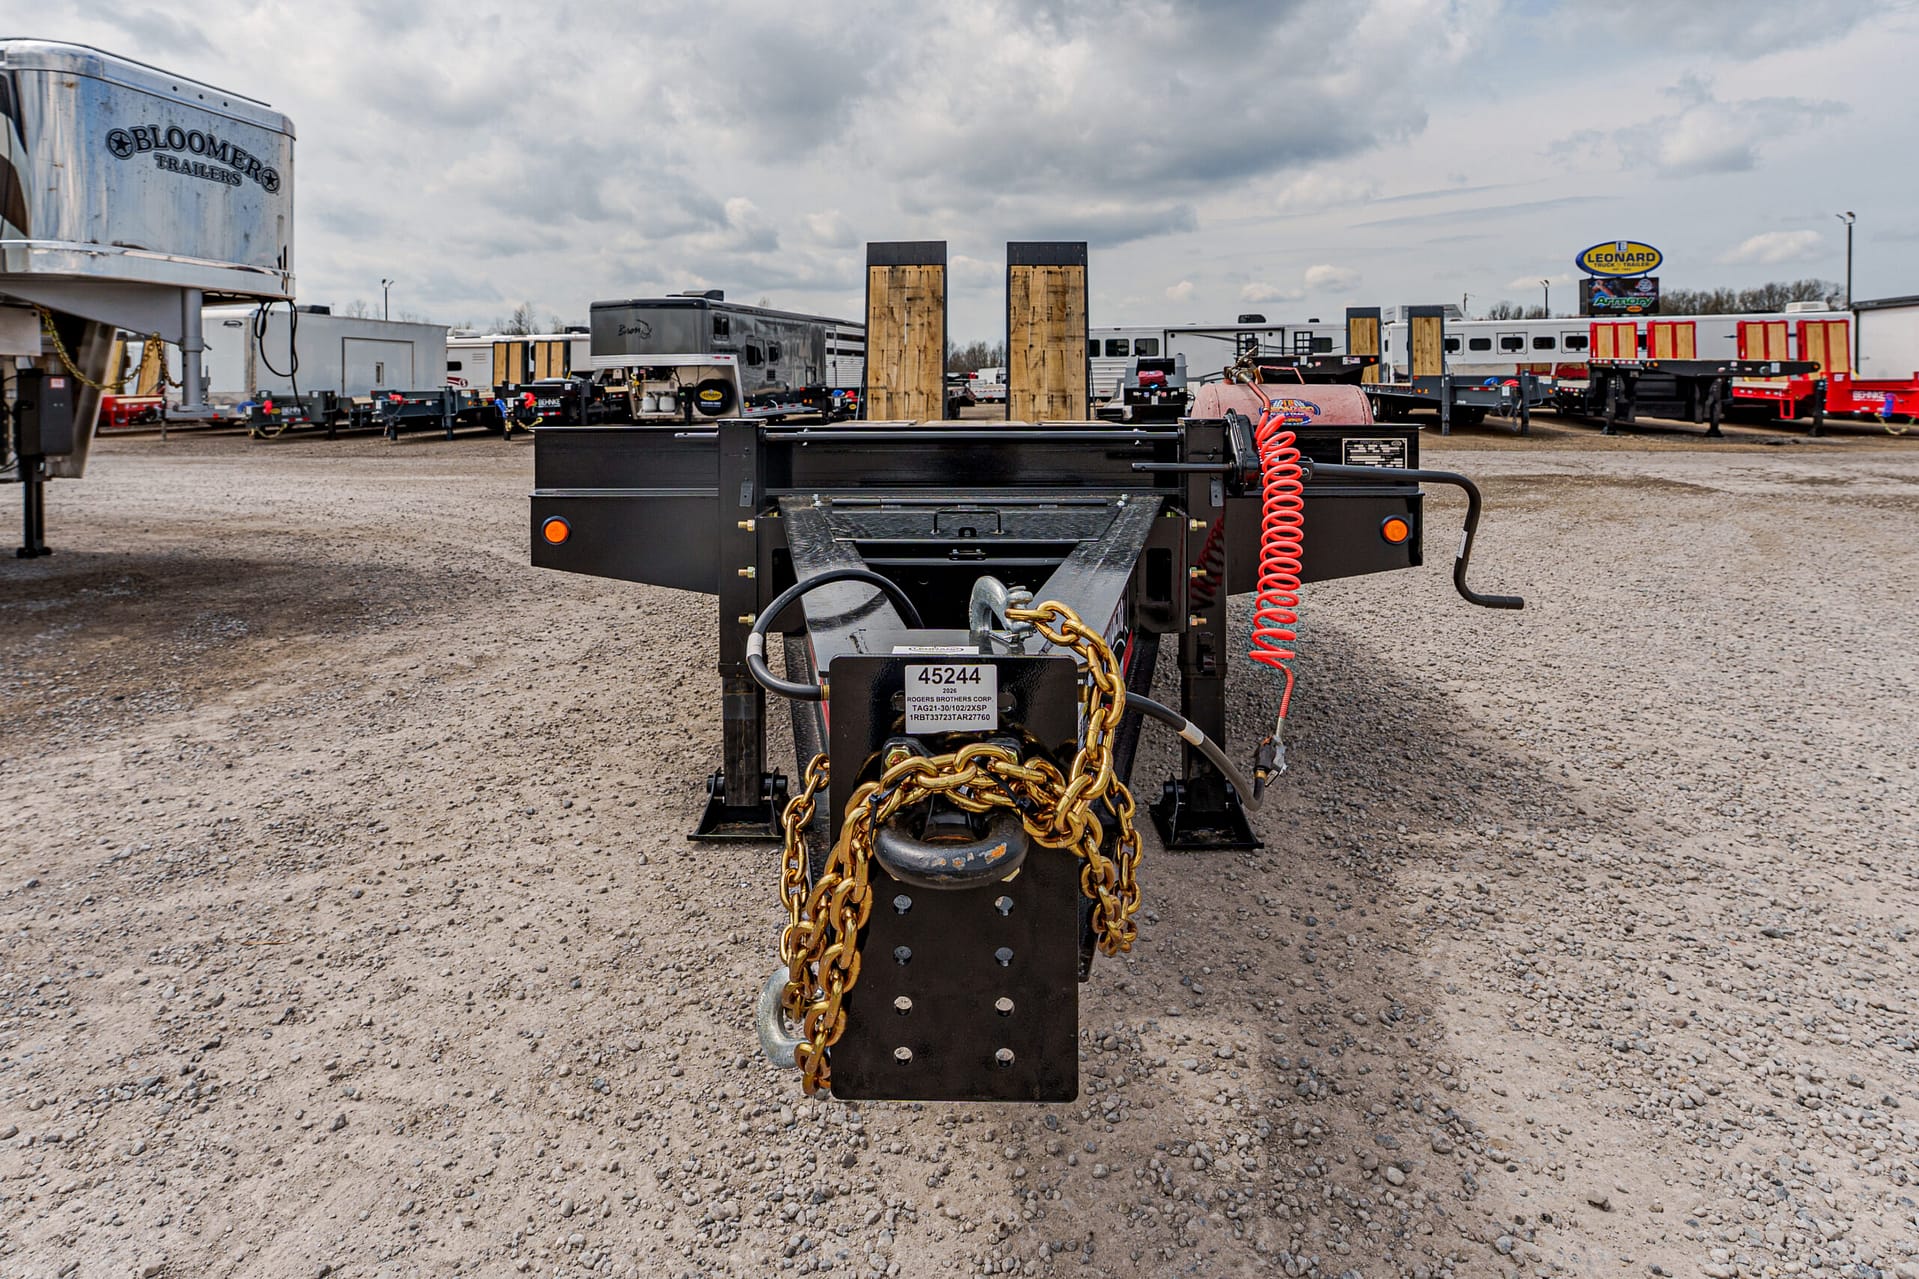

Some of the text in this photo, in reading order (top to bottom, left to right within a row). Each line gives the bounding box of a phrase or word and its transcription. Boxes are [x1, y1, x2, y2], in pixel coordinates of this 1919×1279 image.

[130, 125, 263, 184] BLOOMER
[155, 153, 242, 187] TRAILERS
[1587, 252, 1656, 263] LEONARD
[1593, 297, 1654, 308] Armory
[918, 667, 981, 684] 45244
[910, 713, 991, 721] 1RBT33723TAR27760
